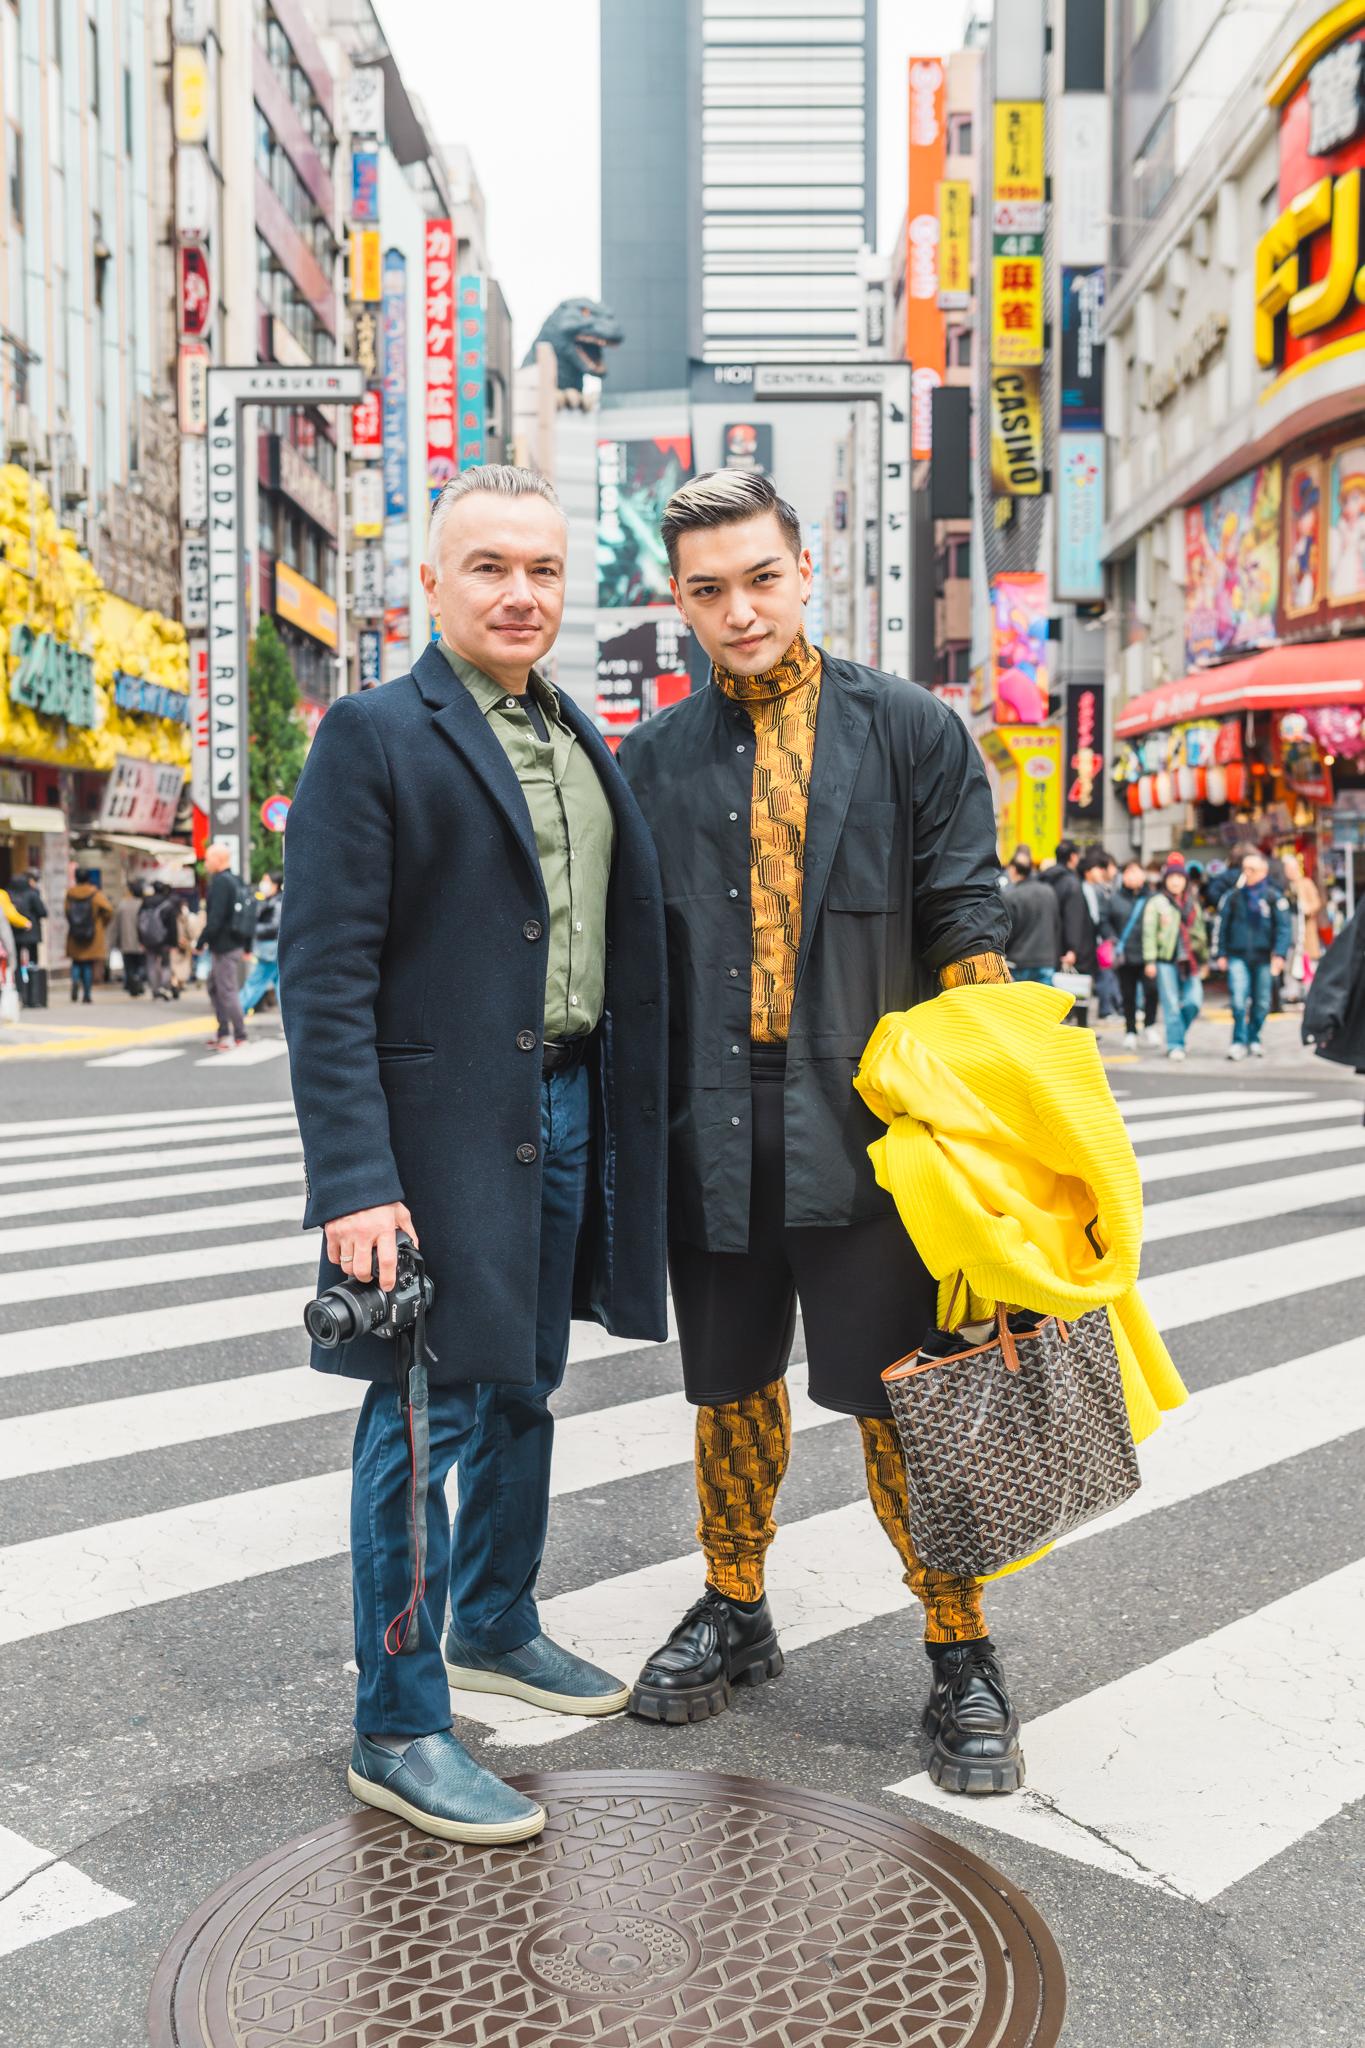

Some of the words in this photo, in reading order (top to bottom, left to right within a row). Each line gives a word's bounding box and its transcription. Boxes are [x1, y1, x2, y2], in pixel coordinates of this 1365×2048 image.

[1002, 235, 1036, 256] 4F
[1002, 263, 1034, 330] 麻雀
[763, 372, 834, 384] CENTRAL
[843, 372, 885, 384] ROAD
[996, 375, 1038, 484] CASINO
[213, 437, 233, 639] GODZILLA
[216, 666, 234, 760] ROAD
